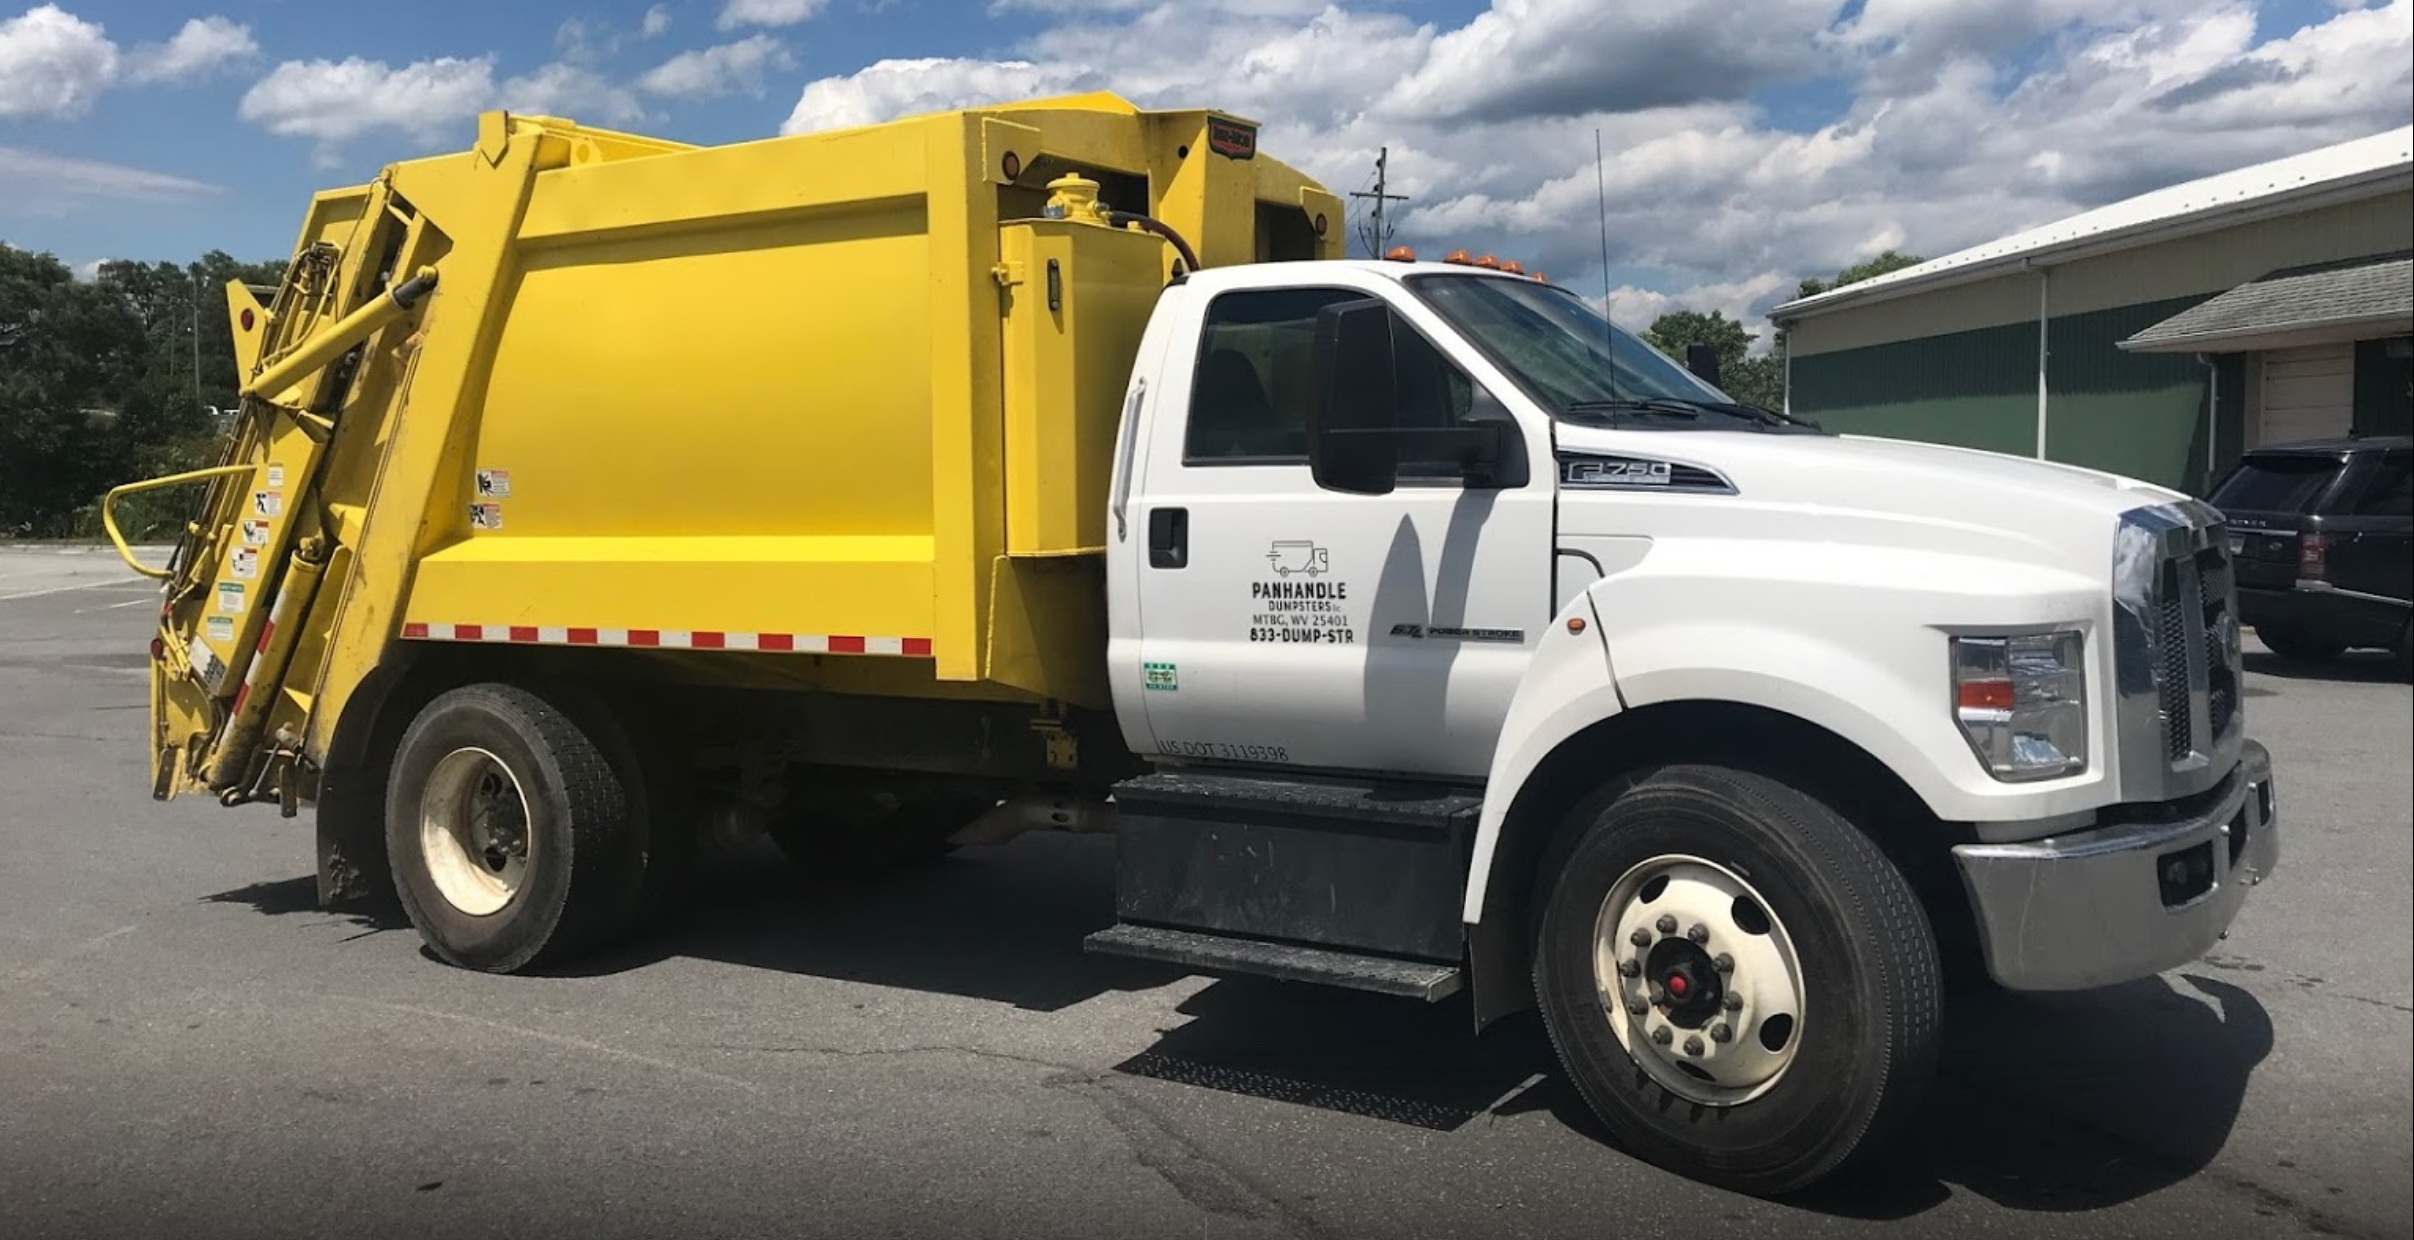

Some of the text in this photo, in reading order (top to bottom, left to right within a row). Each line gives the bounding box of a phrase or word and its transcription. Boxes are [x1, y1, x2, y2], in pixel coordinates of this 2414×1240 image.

[1252, 582, 1347, 599] PANHANDLE
[1268, 601, 1332, 612] DUMPSTERS
[1291, 615, 1309, 626] WV
[1312, 616, 1348, 627] 25401
[1250, 628, 1354, 643] 833-DUMP-STR
[1473, 630, 1521, 638] STROKE
[1160, 740, 1289, 762] US DOT 3119398
